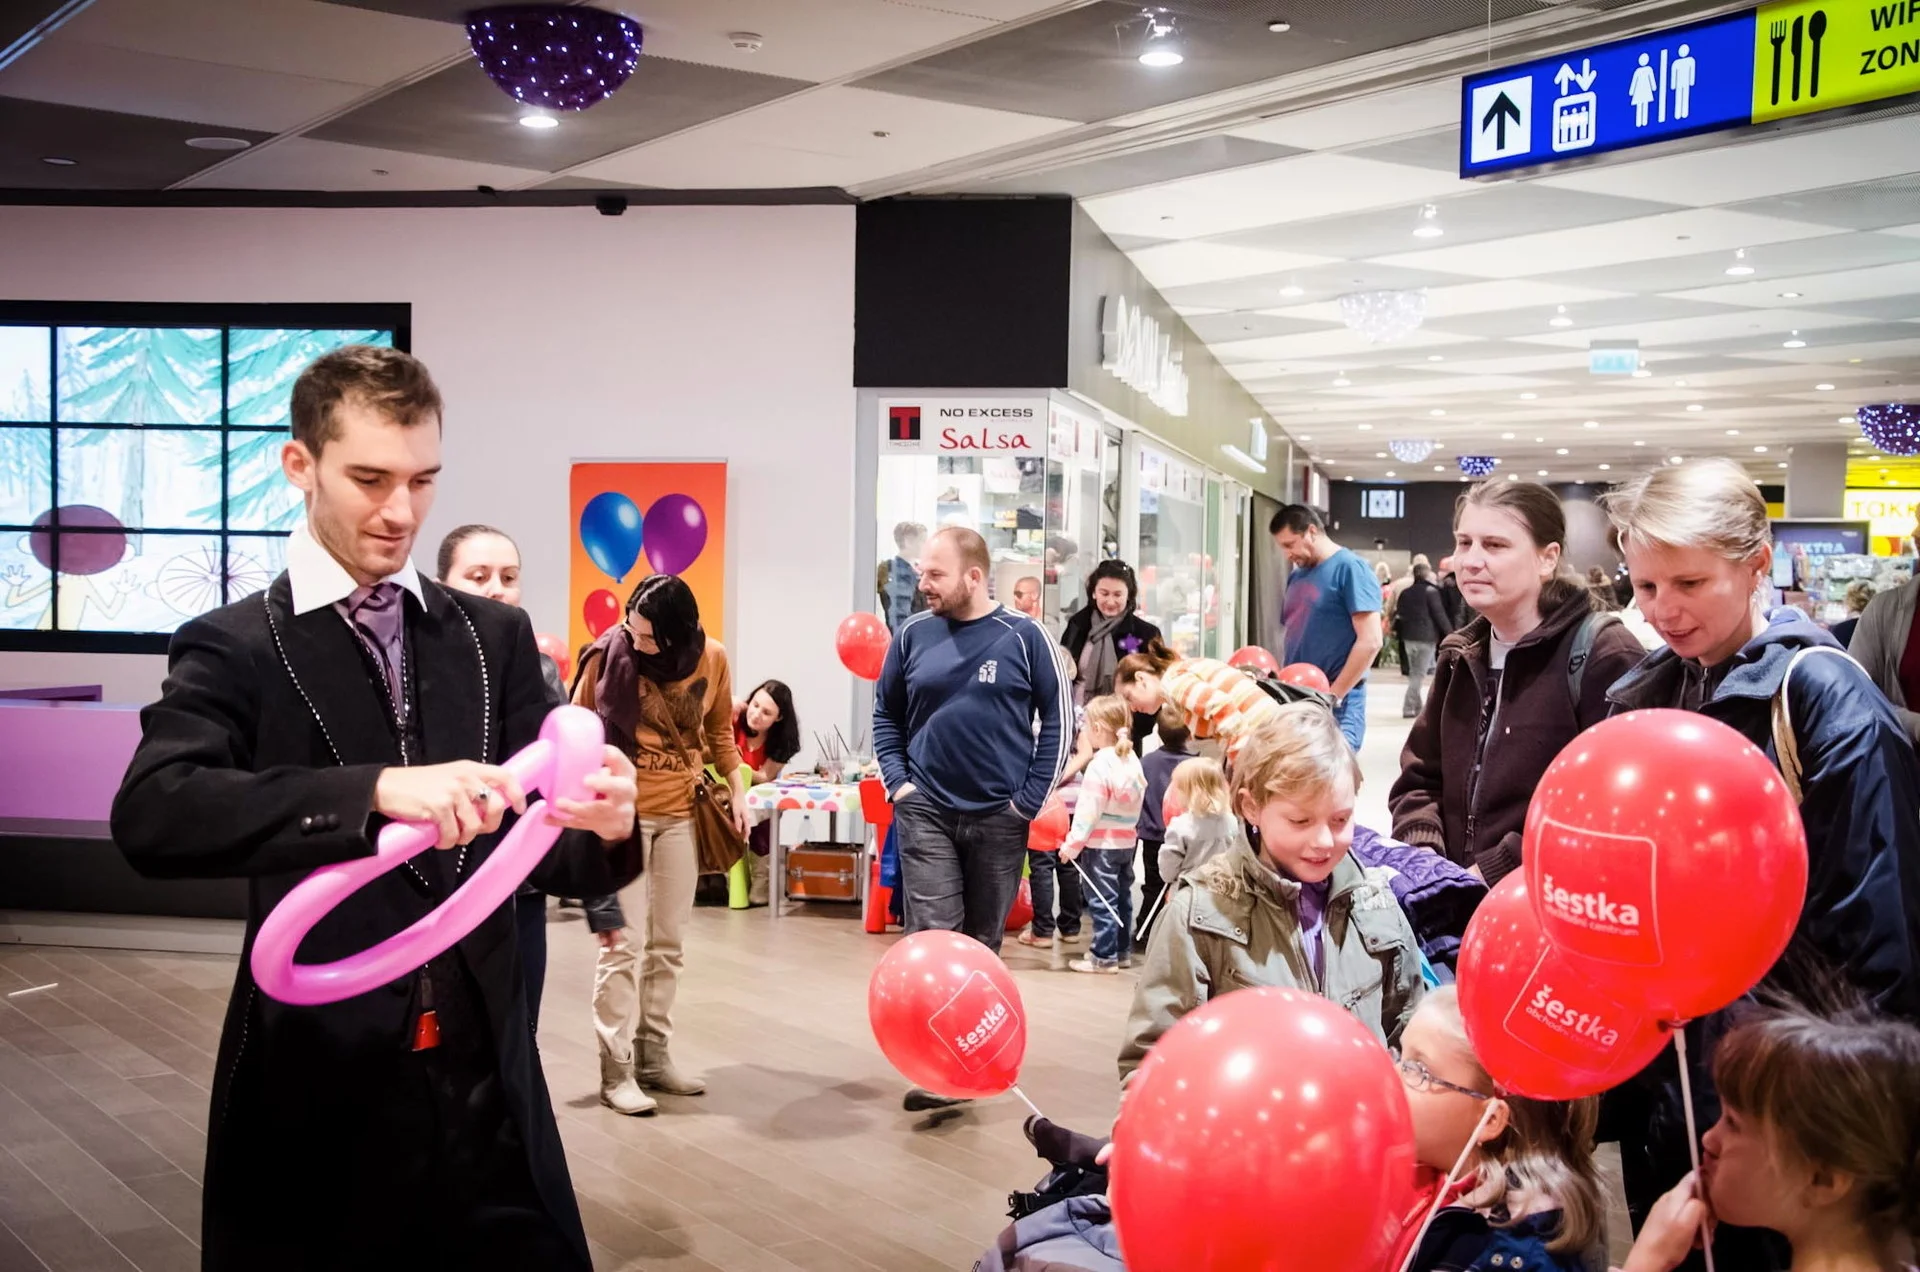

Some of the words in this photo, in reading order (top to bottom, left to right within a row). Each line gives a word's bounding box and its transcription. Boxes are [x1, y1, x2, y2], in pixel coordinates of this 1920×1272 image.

[1860, 39, 1920, 75] ZON
[940, 408, 964, 418] NO
[968, 408, 1034, 418] EXCESS
[939, 428, 1031, 449] Salsa
[1543, 873, 1639, 926] šestka
[955, 1003, 1006, 1052] šestka
[1531, 984, 1619, 1046] šestka
